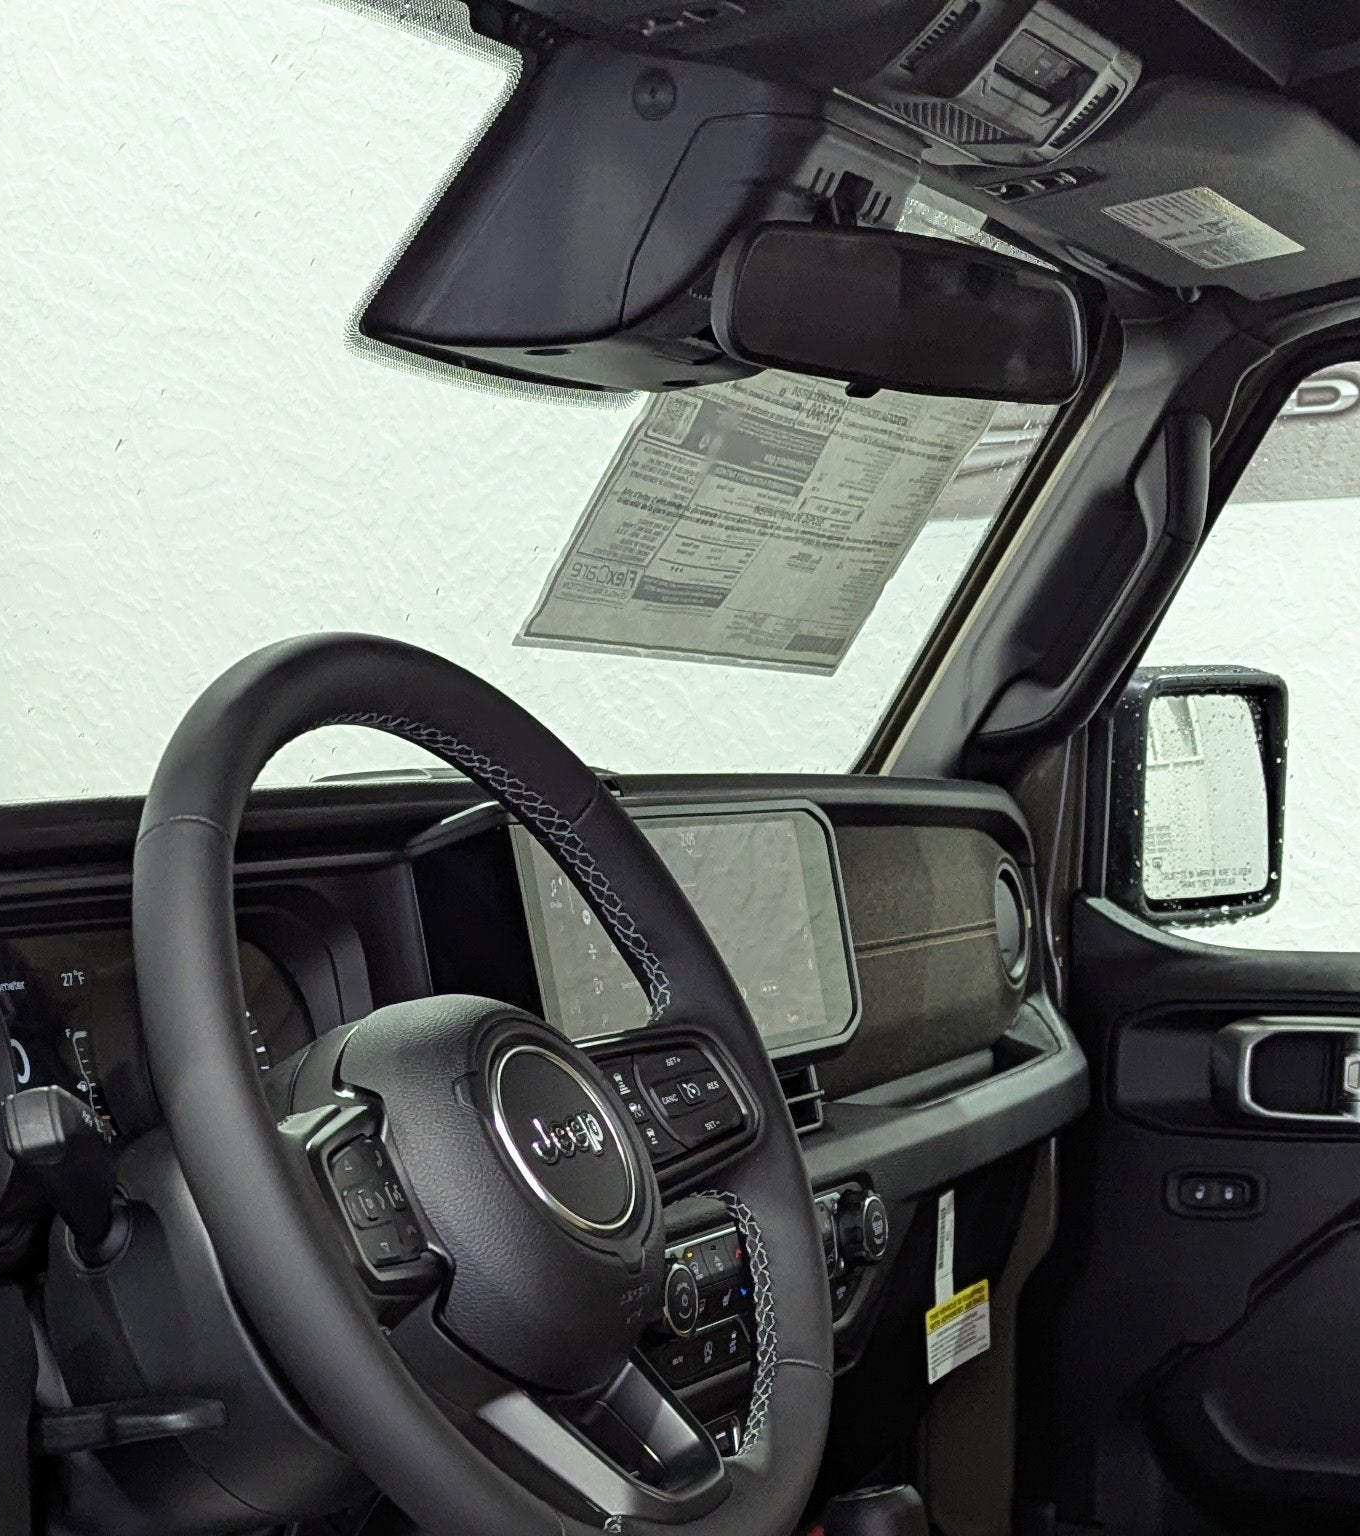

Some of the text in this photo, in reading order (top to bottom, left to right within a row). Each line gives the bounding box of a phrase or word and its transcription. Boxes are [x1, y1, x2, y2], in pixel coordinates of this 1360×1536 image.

[706, 1080, 720, 1091] RES
[661, 1094, 680, 1105] CANC
[531, 1110, 605, 1167] Jeep
